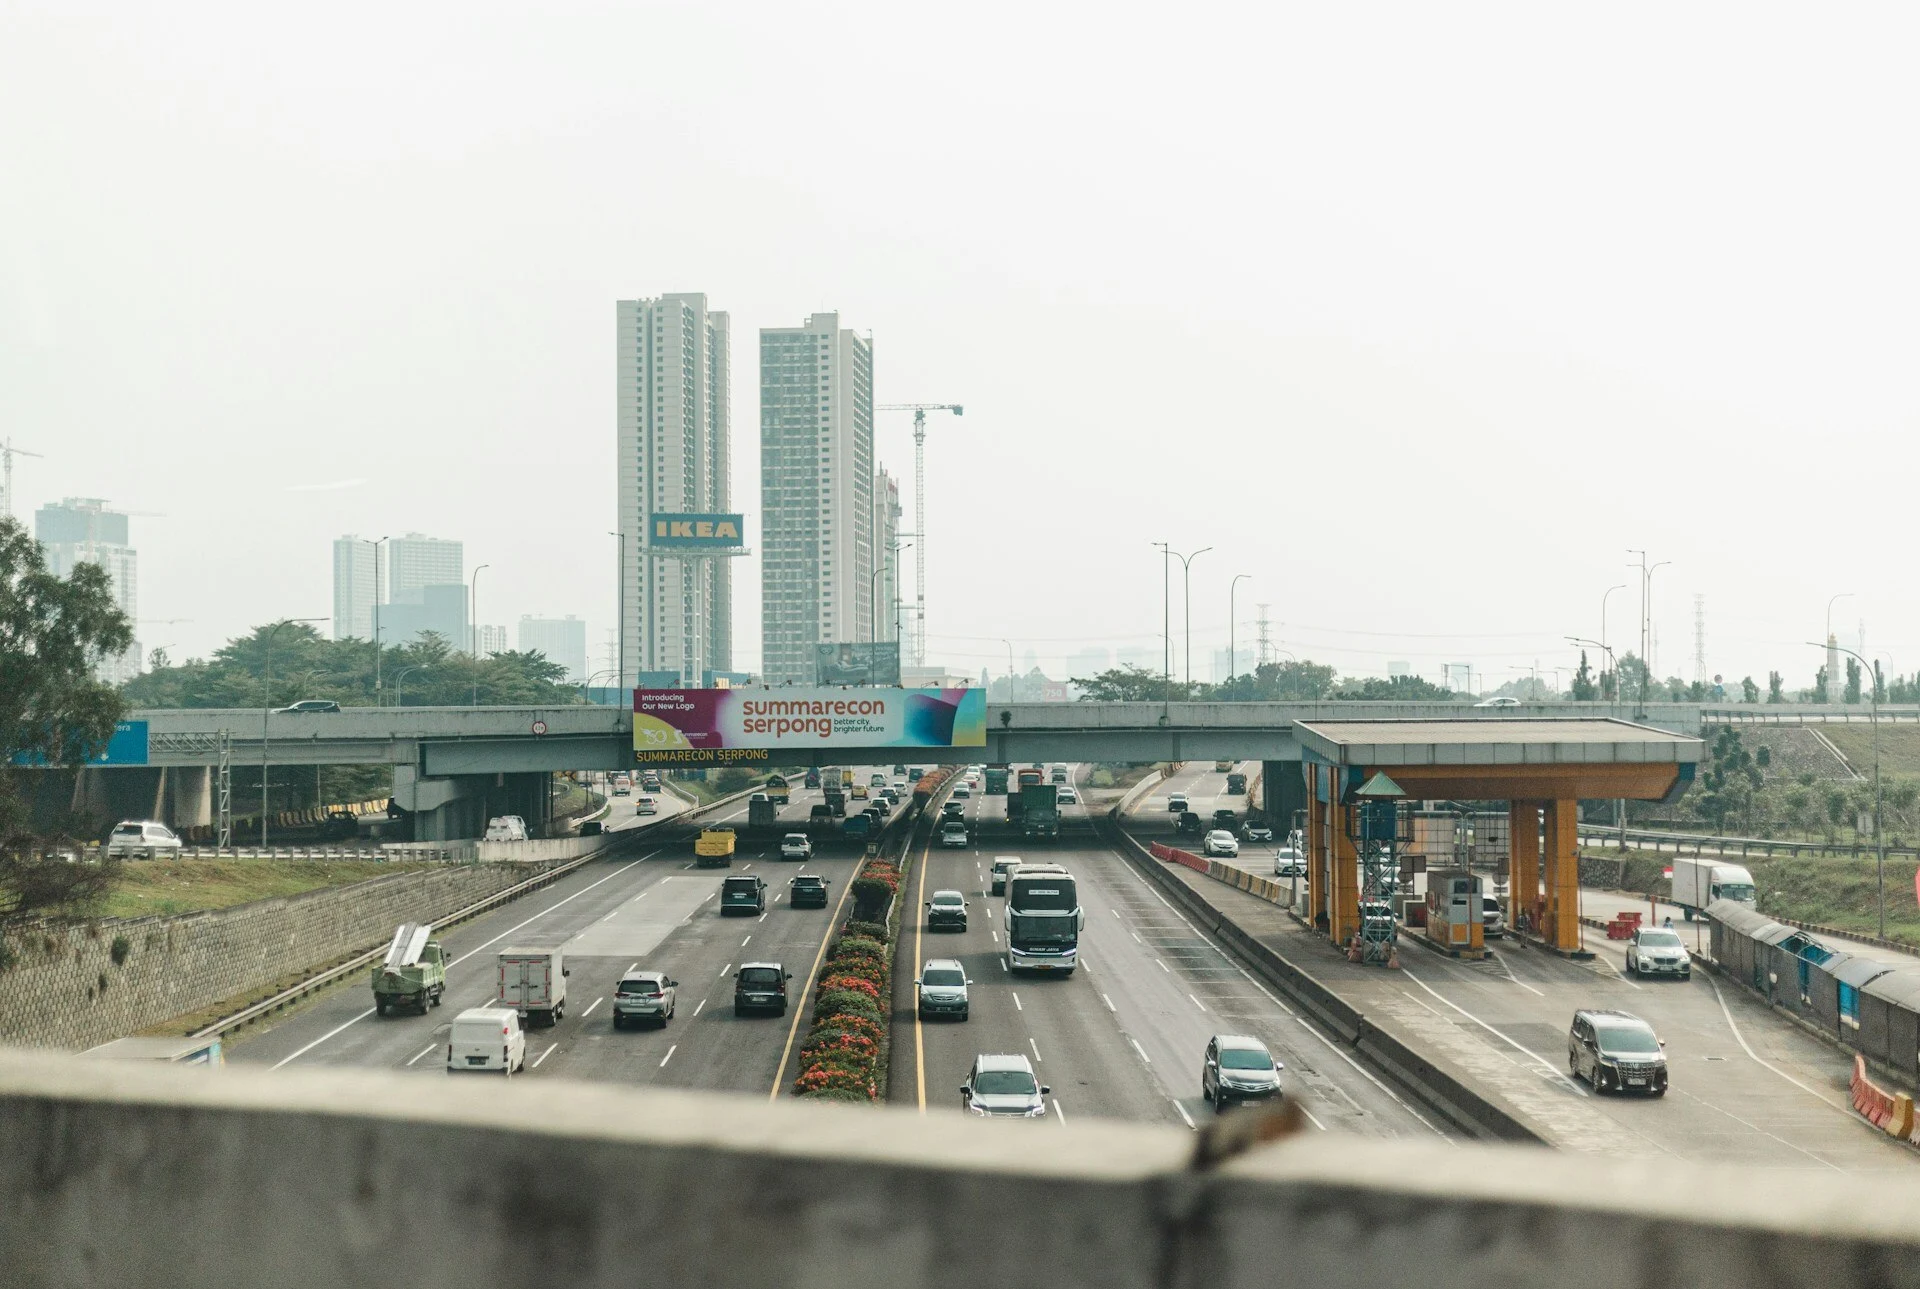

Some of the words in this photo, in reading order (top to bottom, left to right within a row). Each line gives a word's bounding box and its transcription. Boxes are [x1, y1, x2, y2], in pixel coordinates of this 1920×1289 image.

[656, 521, 738, 538] IKEA
[642, 694, 684, 702] Introducing
[1046, 688, 1062, 698] 750
[676, 703, 695, 711] Logo
[743, 700, 885, 716] summarecon
[743, 718, 832, 738] serpong
[834, 726, 862, 734] brighter
[637, 751, 714, 762] SUMMARECON
[717, 749, 768, 761] SERPONG
